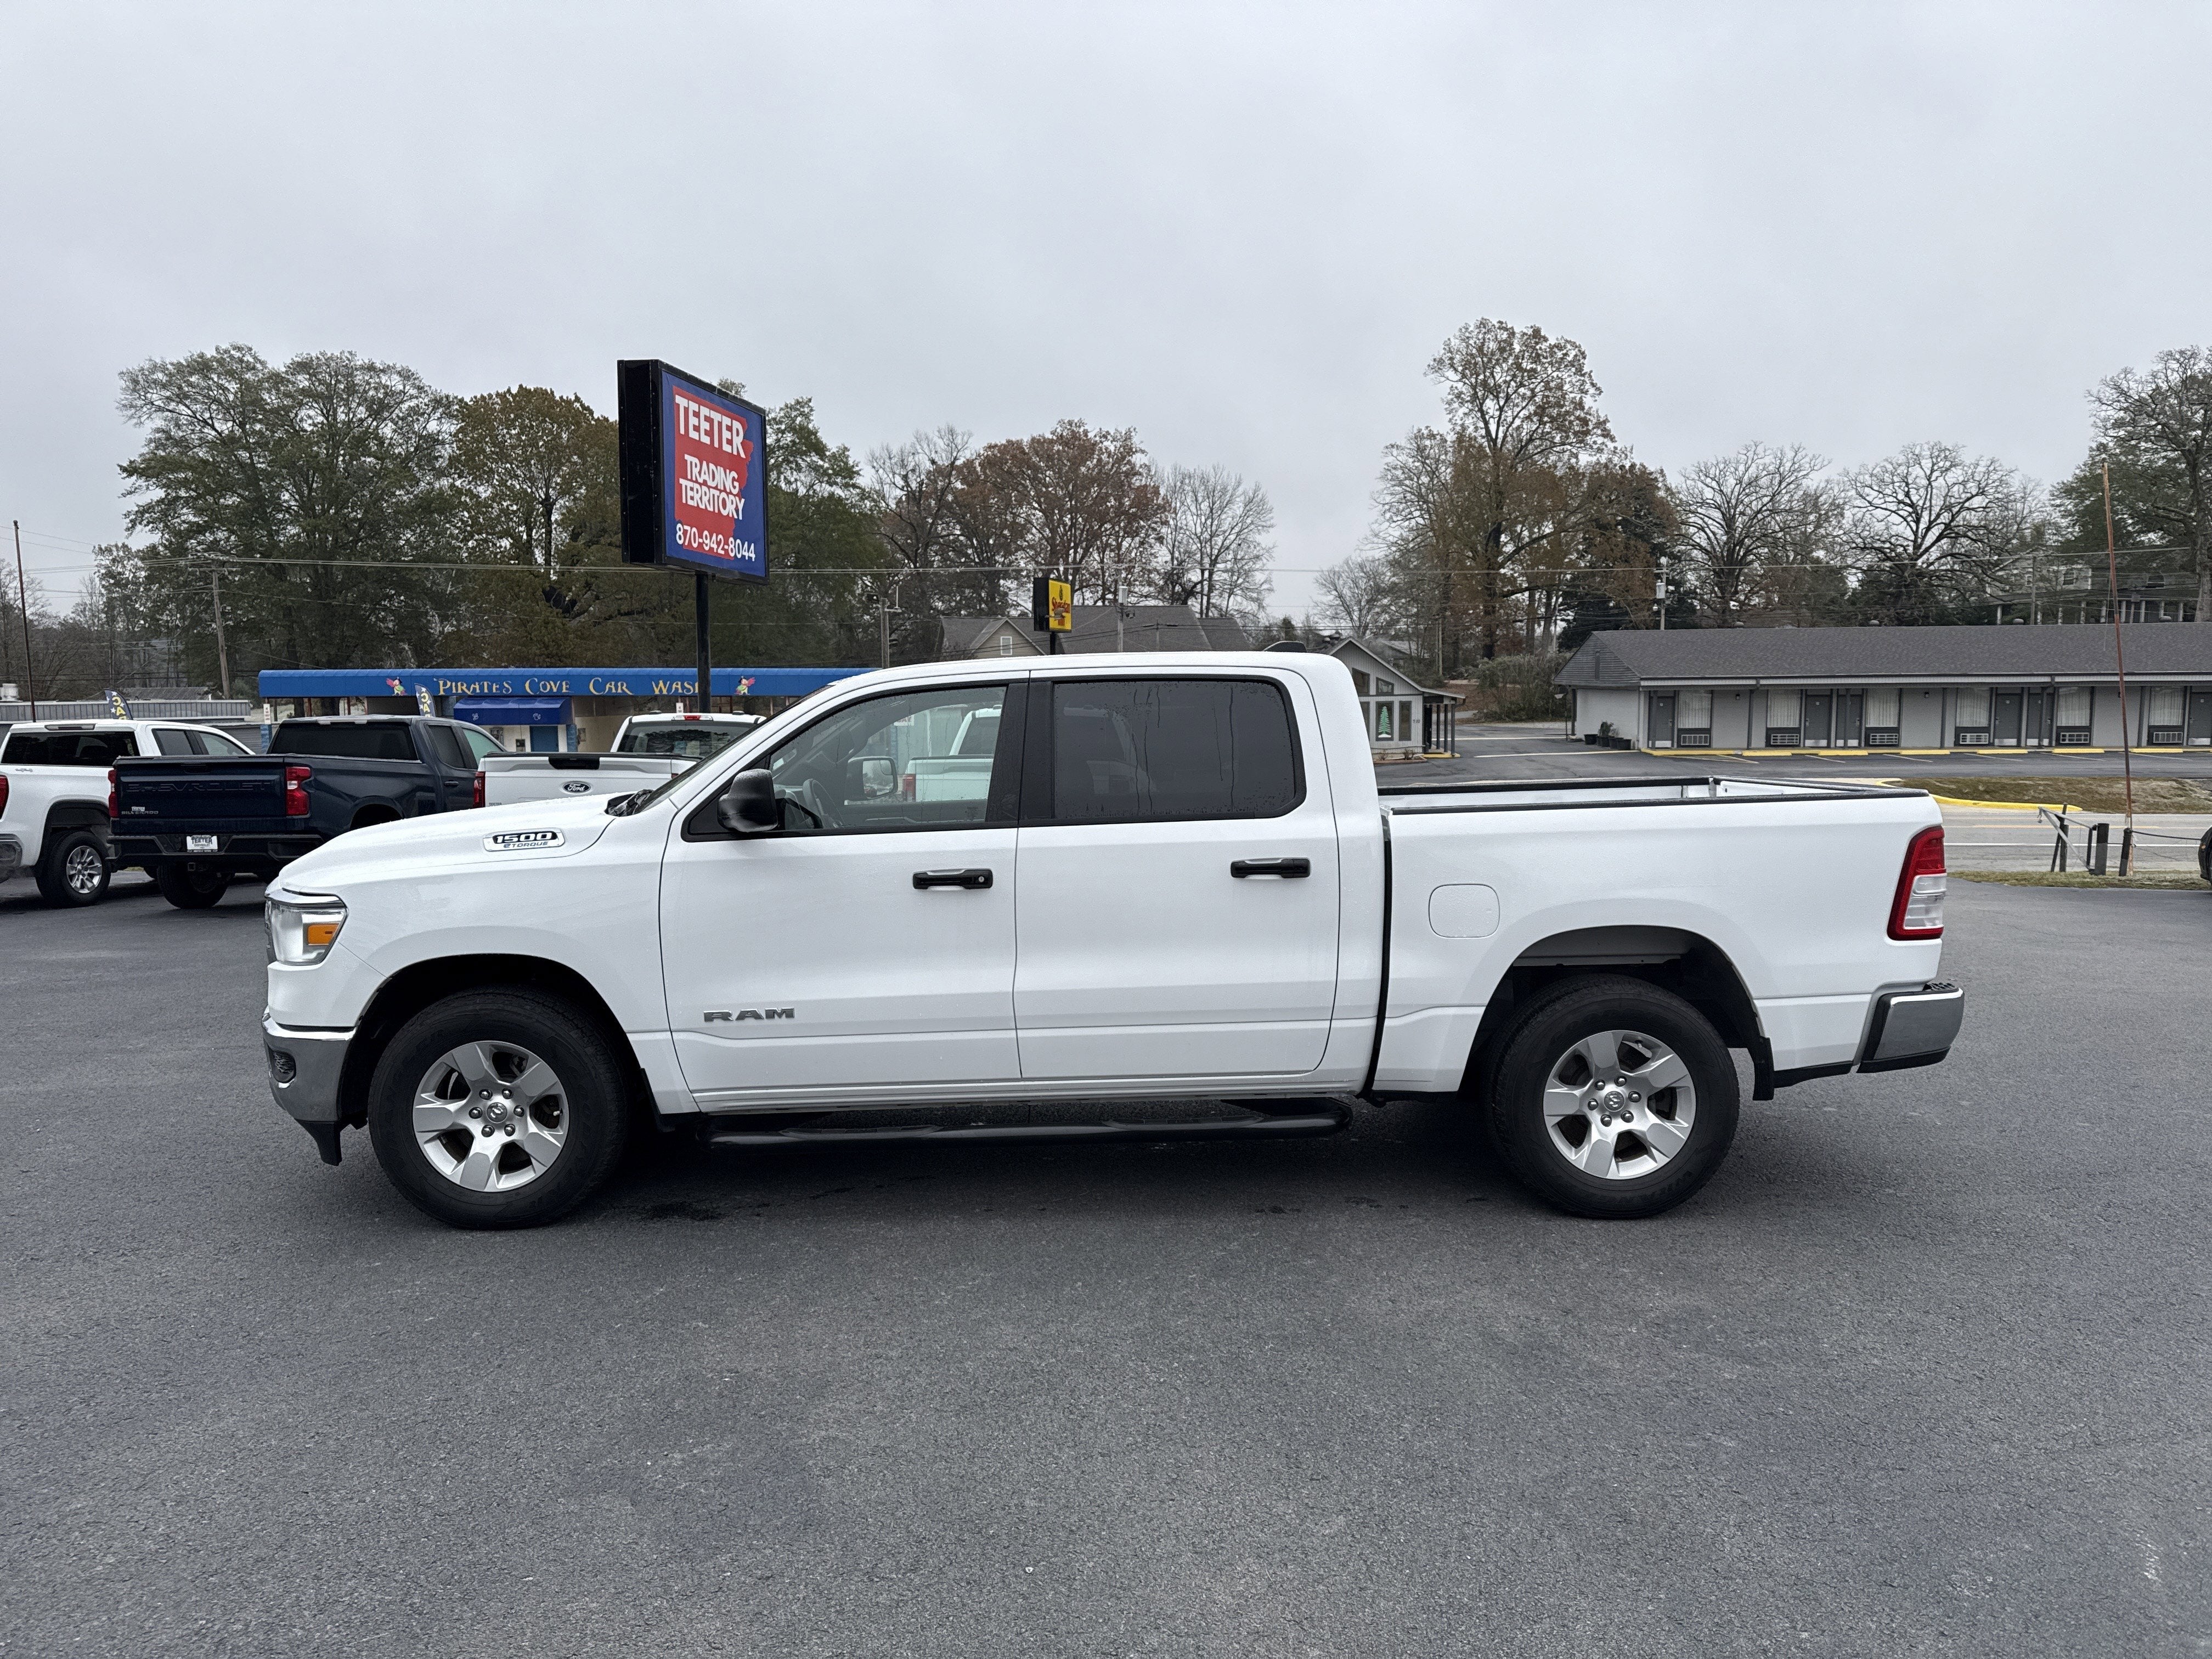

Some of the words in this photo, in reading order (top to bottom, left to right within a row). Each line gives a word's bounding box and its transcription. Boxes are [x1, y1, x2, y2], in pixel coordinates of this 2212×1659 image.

[675, 395, 746, 458] TEETER
[685, 454, 739, 494] TRADING
[679, 478, 745, 520] TERRITORY
[676, 523, 755, 562] 870-942-8044
[433, 678, 512, 696] PIRATES
[525, 678, 574, 695] COVE
[589, 677, 635, 695] CAR
[126, 782, 270, 792] CHEVROLET
[567, 783, 586, 791] Ford
[496, 832, 552, 843] 1500
[703, 1007, 795, 1022] RAM
